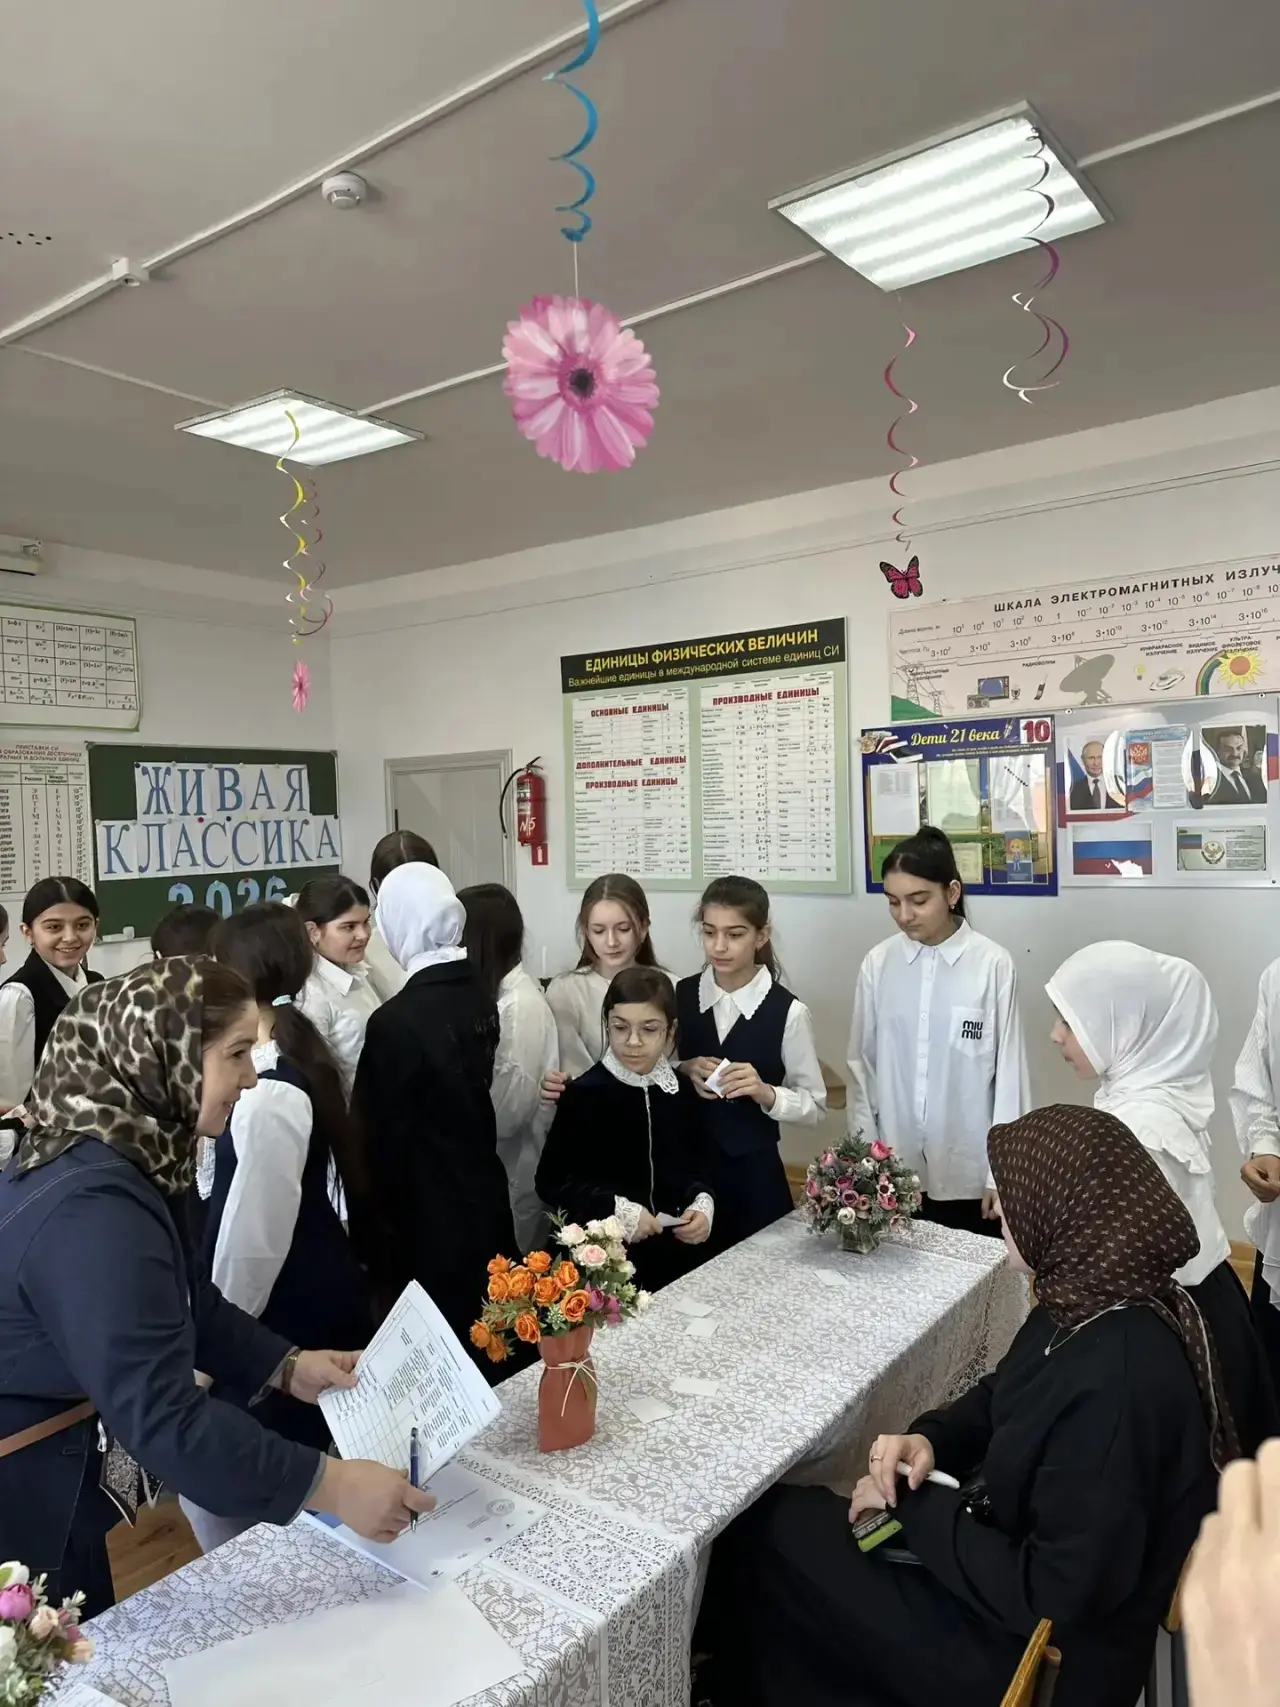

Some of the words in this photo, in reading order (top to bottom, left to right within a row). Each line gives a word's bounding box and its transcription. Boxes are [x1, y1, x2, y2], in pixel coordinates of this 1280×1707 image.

[994, 597, 1042, 613] ШКАЛА
[1050, 573, 1215, 605] ЭЛЕКТРОМАГНИТНЫХ
[1033, 615, 1043, 623] 10
[1056, 612, 1061, 620] 1
[585, 652, 649, 673] ЕДИНИЦЫ
[651, 639, 746, 664] ФИЗИЧЕСКИХ
[748, 628, 818, 651] ВЕЛИЧИН
[568, 674, 617, 687] Важнейшие
[619, 671, 657, 683] единицы
[658, 669, 664, 677] в
[666, 658, 739, 676] международной
[741, 655, 782, 667] системе
[783, 650, 821, 663] единиц
[823, 645, 840, 657] СИ
[712, 692, 773, 706] ПРОИЗВОДНЫЕ
[777, 687, 820, 700] ЕДИНИЦЫ
[591, 706, 629, 718] ОСНОВНЫЕ
[632, 703, 669, 714] ЕДИНИЦЫ
[910, 732, 947, 746] Дети
[950, 728, 967, 743] 21
[968, 728, 1001, 742] века
[1021, 719, 1050, 743] 10
[576, 758, 643, 770] ДОПОЛНИТЕЛЬНЫЕ
[650, 755, 687, 766] ЕДИНИЦЫ
[141, 766, 308, 816] ЖИВАЯ
[585, 779, 638, 789] ПРОИЗВОДНЫЕ
[641, 777, 678, 787] ЕДИНИЦЫ
[103, 818, 340, 875] КЛАССИКА
[961, 1029, 983, 1040] miu
[962, 1020, 984, 1031] miu
